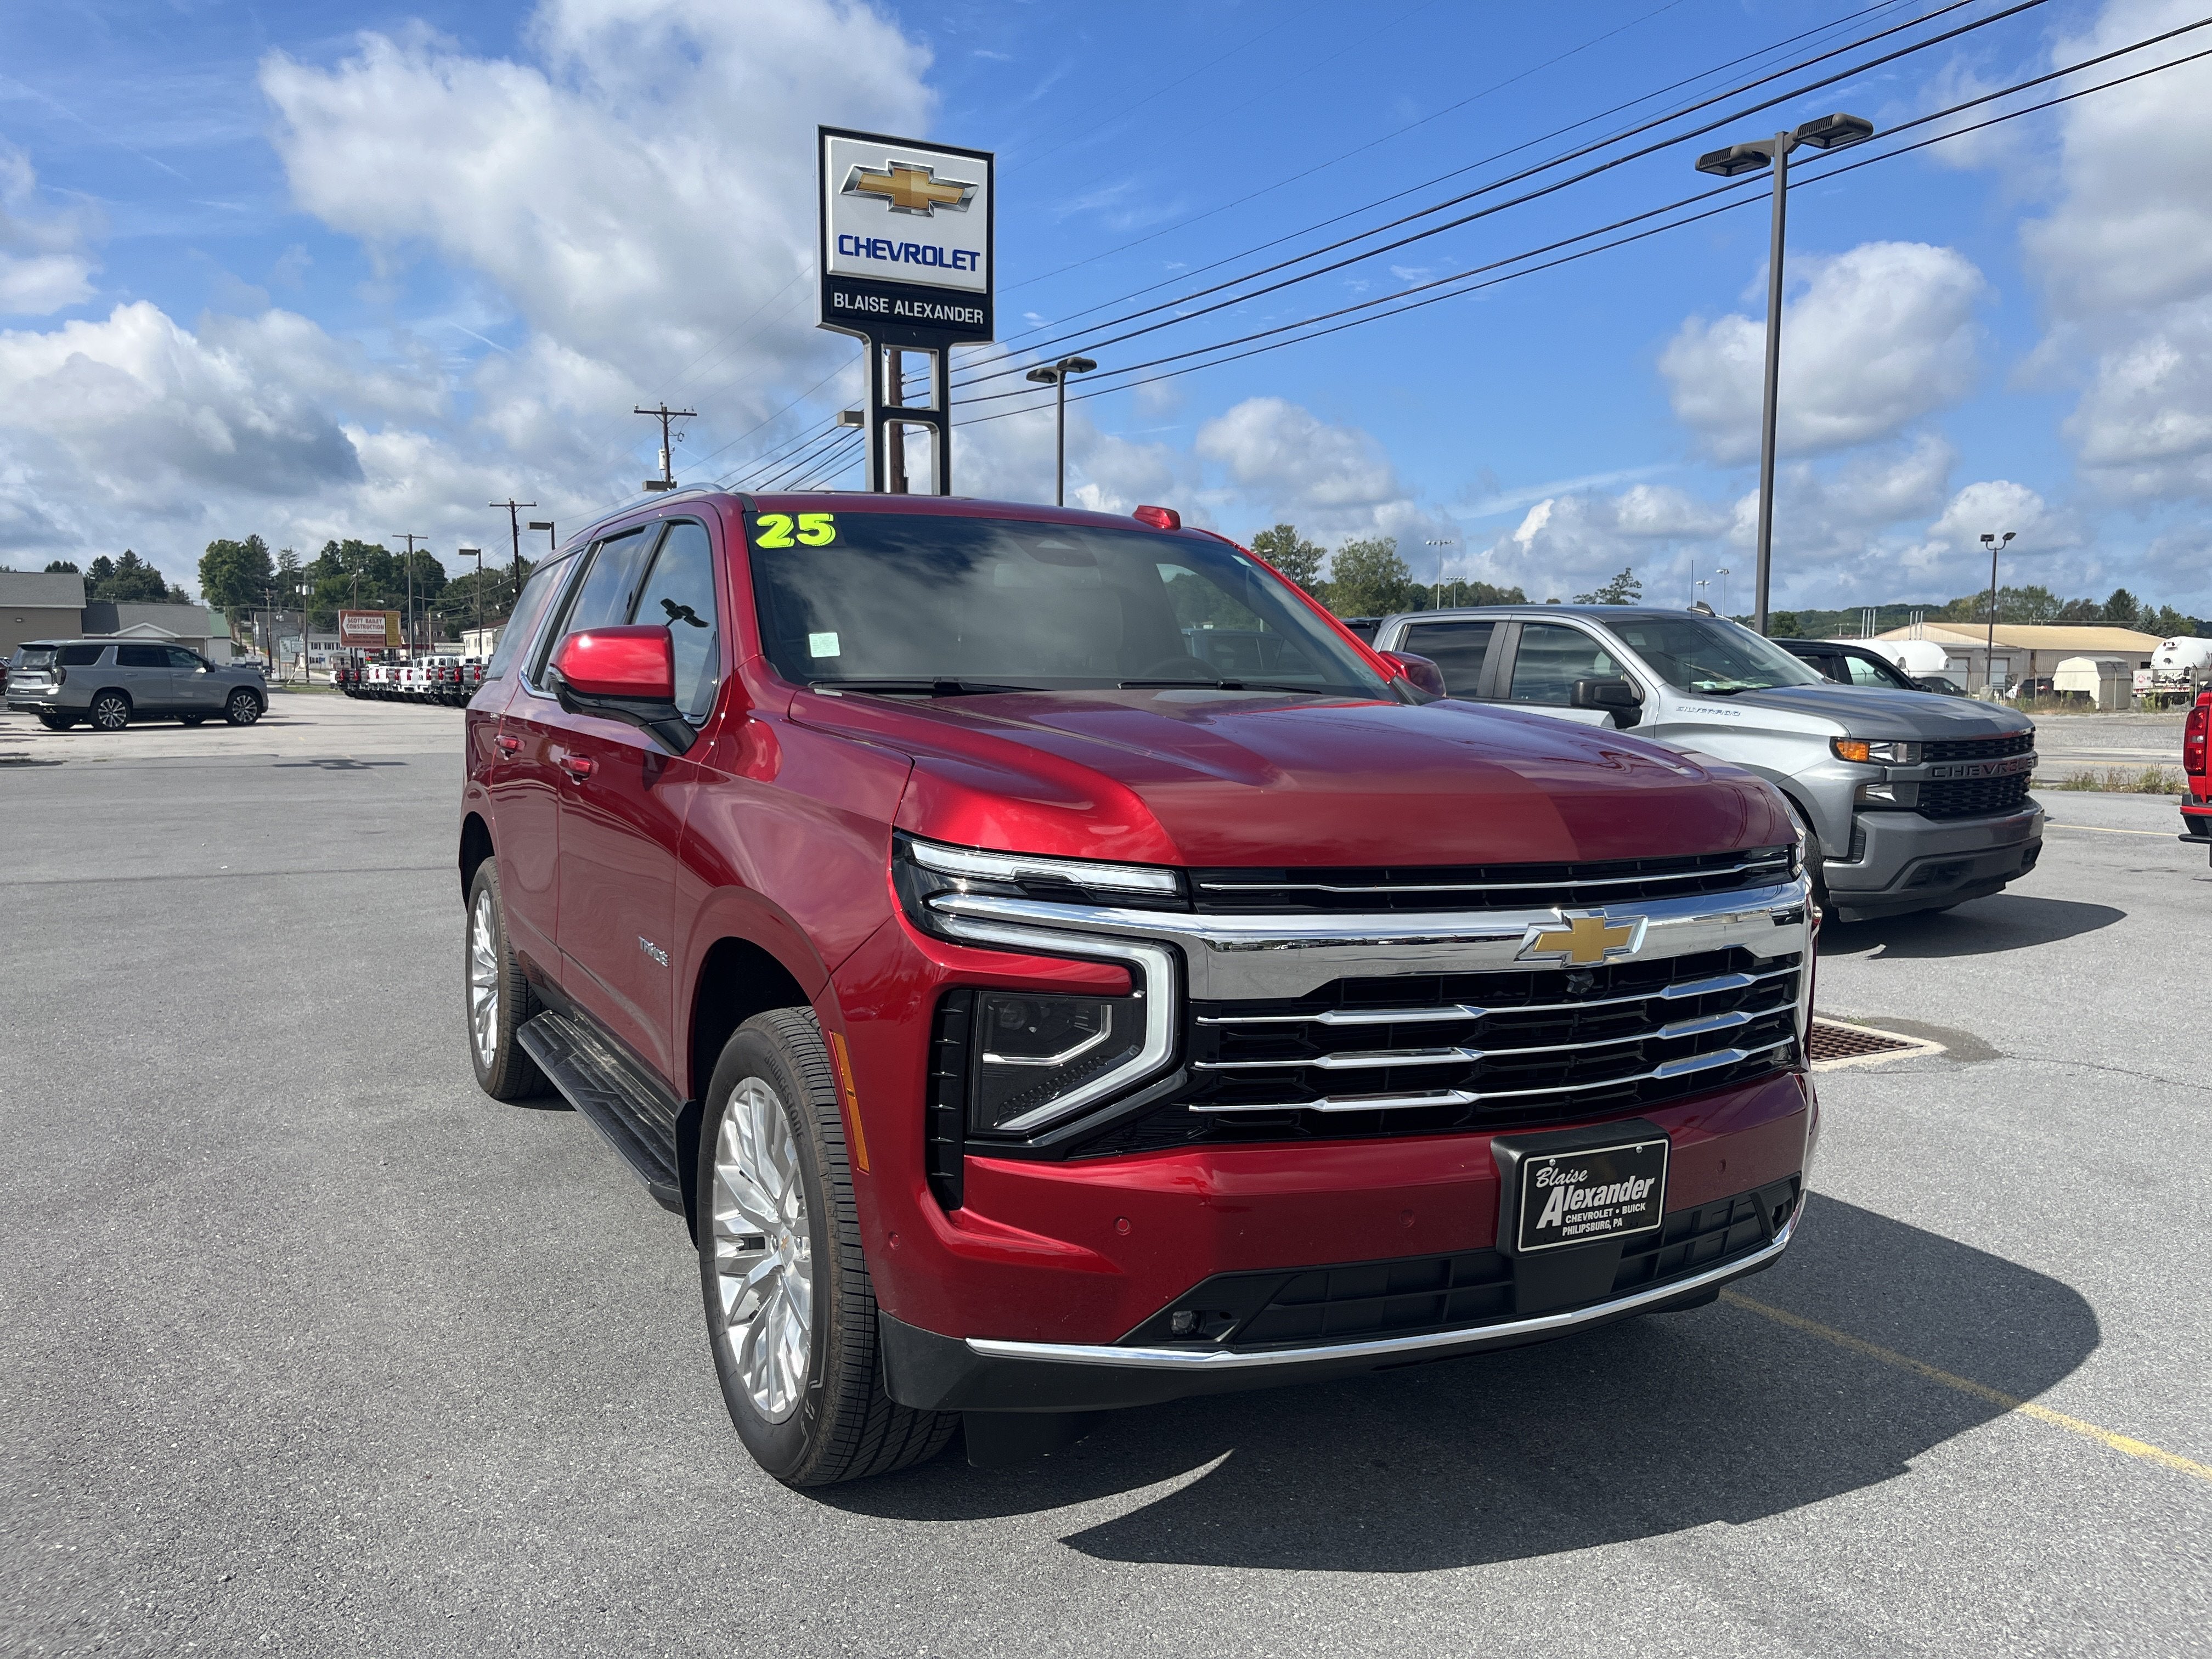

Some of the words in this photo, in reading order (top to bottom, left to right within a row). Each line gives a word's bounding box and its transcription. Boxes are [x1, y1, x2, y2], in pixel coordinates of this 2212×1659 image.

[838, 234, 980, 272] CHEVROLET
[833, 292, 889, 314] BLAISE
[894, 300, 984, 324] ALEXANDER
[755, 514, 836, 549] 25
[1676, 706, 1741, 716] SILVERADO
[1536, 1166, 1588, 1188] Blaise
[1536, 1175, 1655, 1229] Alexander
[1565, 1208, 1613, 1223] CHEVROLET
[1622, 1202, 1646, 1215] BUICK
[1562, 1219, 1612, 1237] PHILIPSBURG,
[1612, 1217, 1623, 1228] PA
